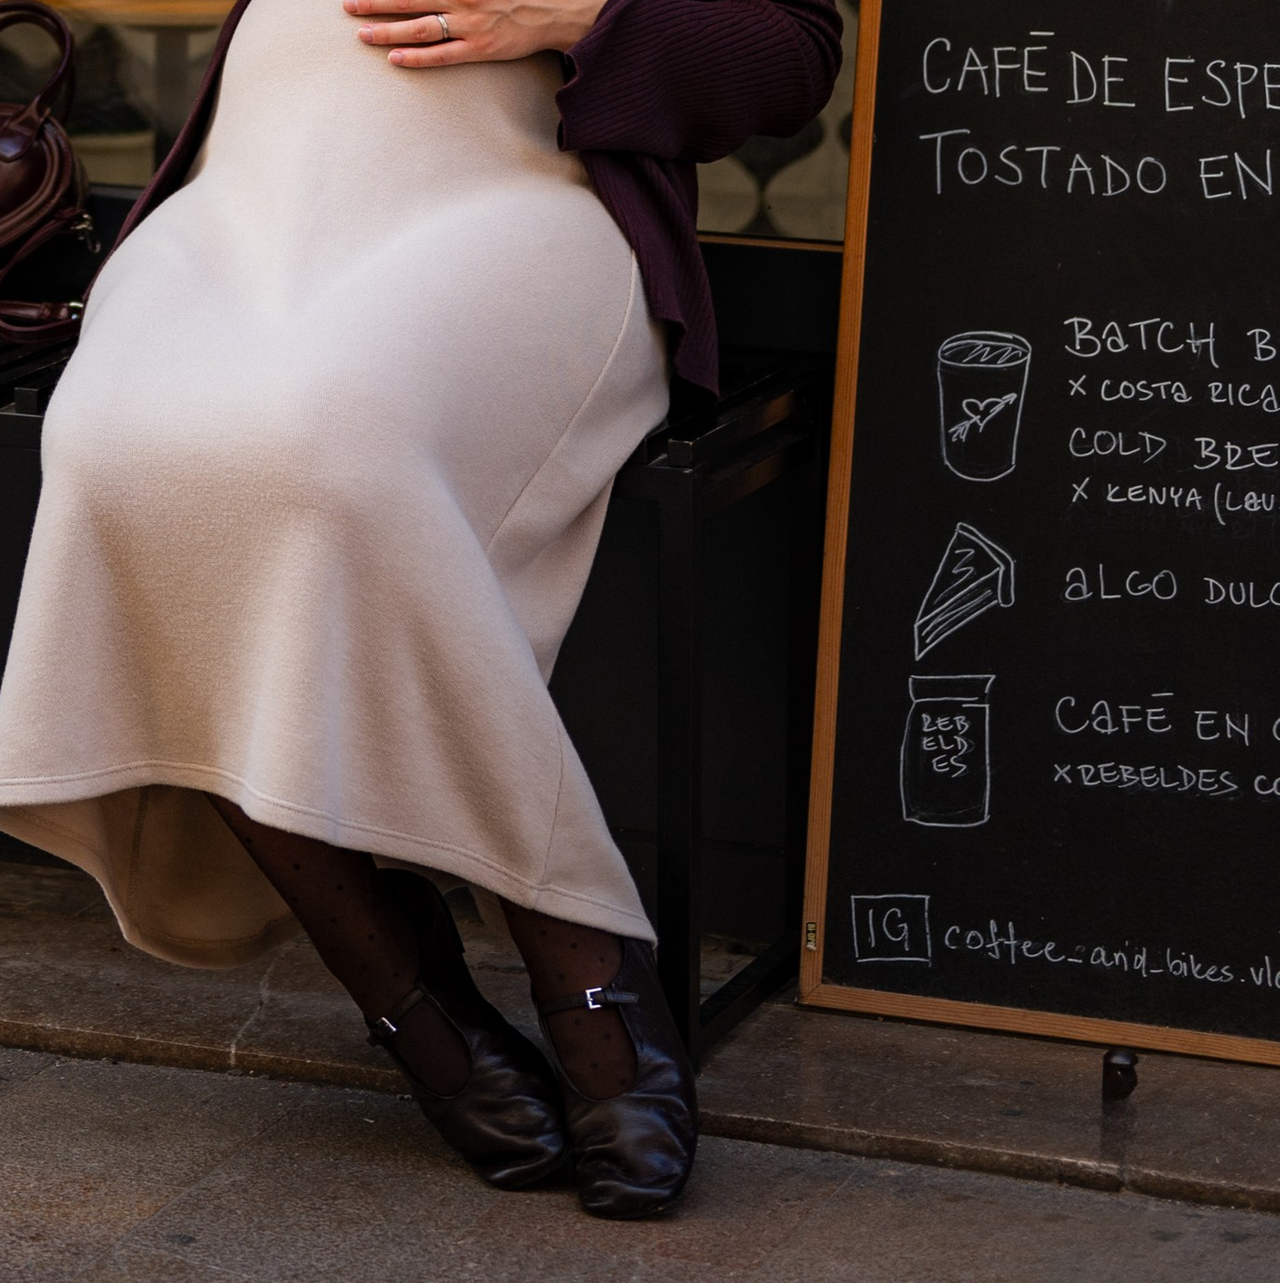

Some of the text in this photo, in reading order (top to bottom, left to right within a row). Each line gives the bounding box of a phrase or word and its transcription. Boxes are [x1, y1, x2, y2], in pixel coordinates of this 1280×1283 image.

[1066, 51, 1136, 107] DE
[919, 128, 1273, 200] TOSTADO EN
[1069, 427, 1168, 463] COLD
[1106, 483, 1202, 511] KENYA
[1195, 710, 1250, 746] EN
[869, 907, 910, 951] IG
